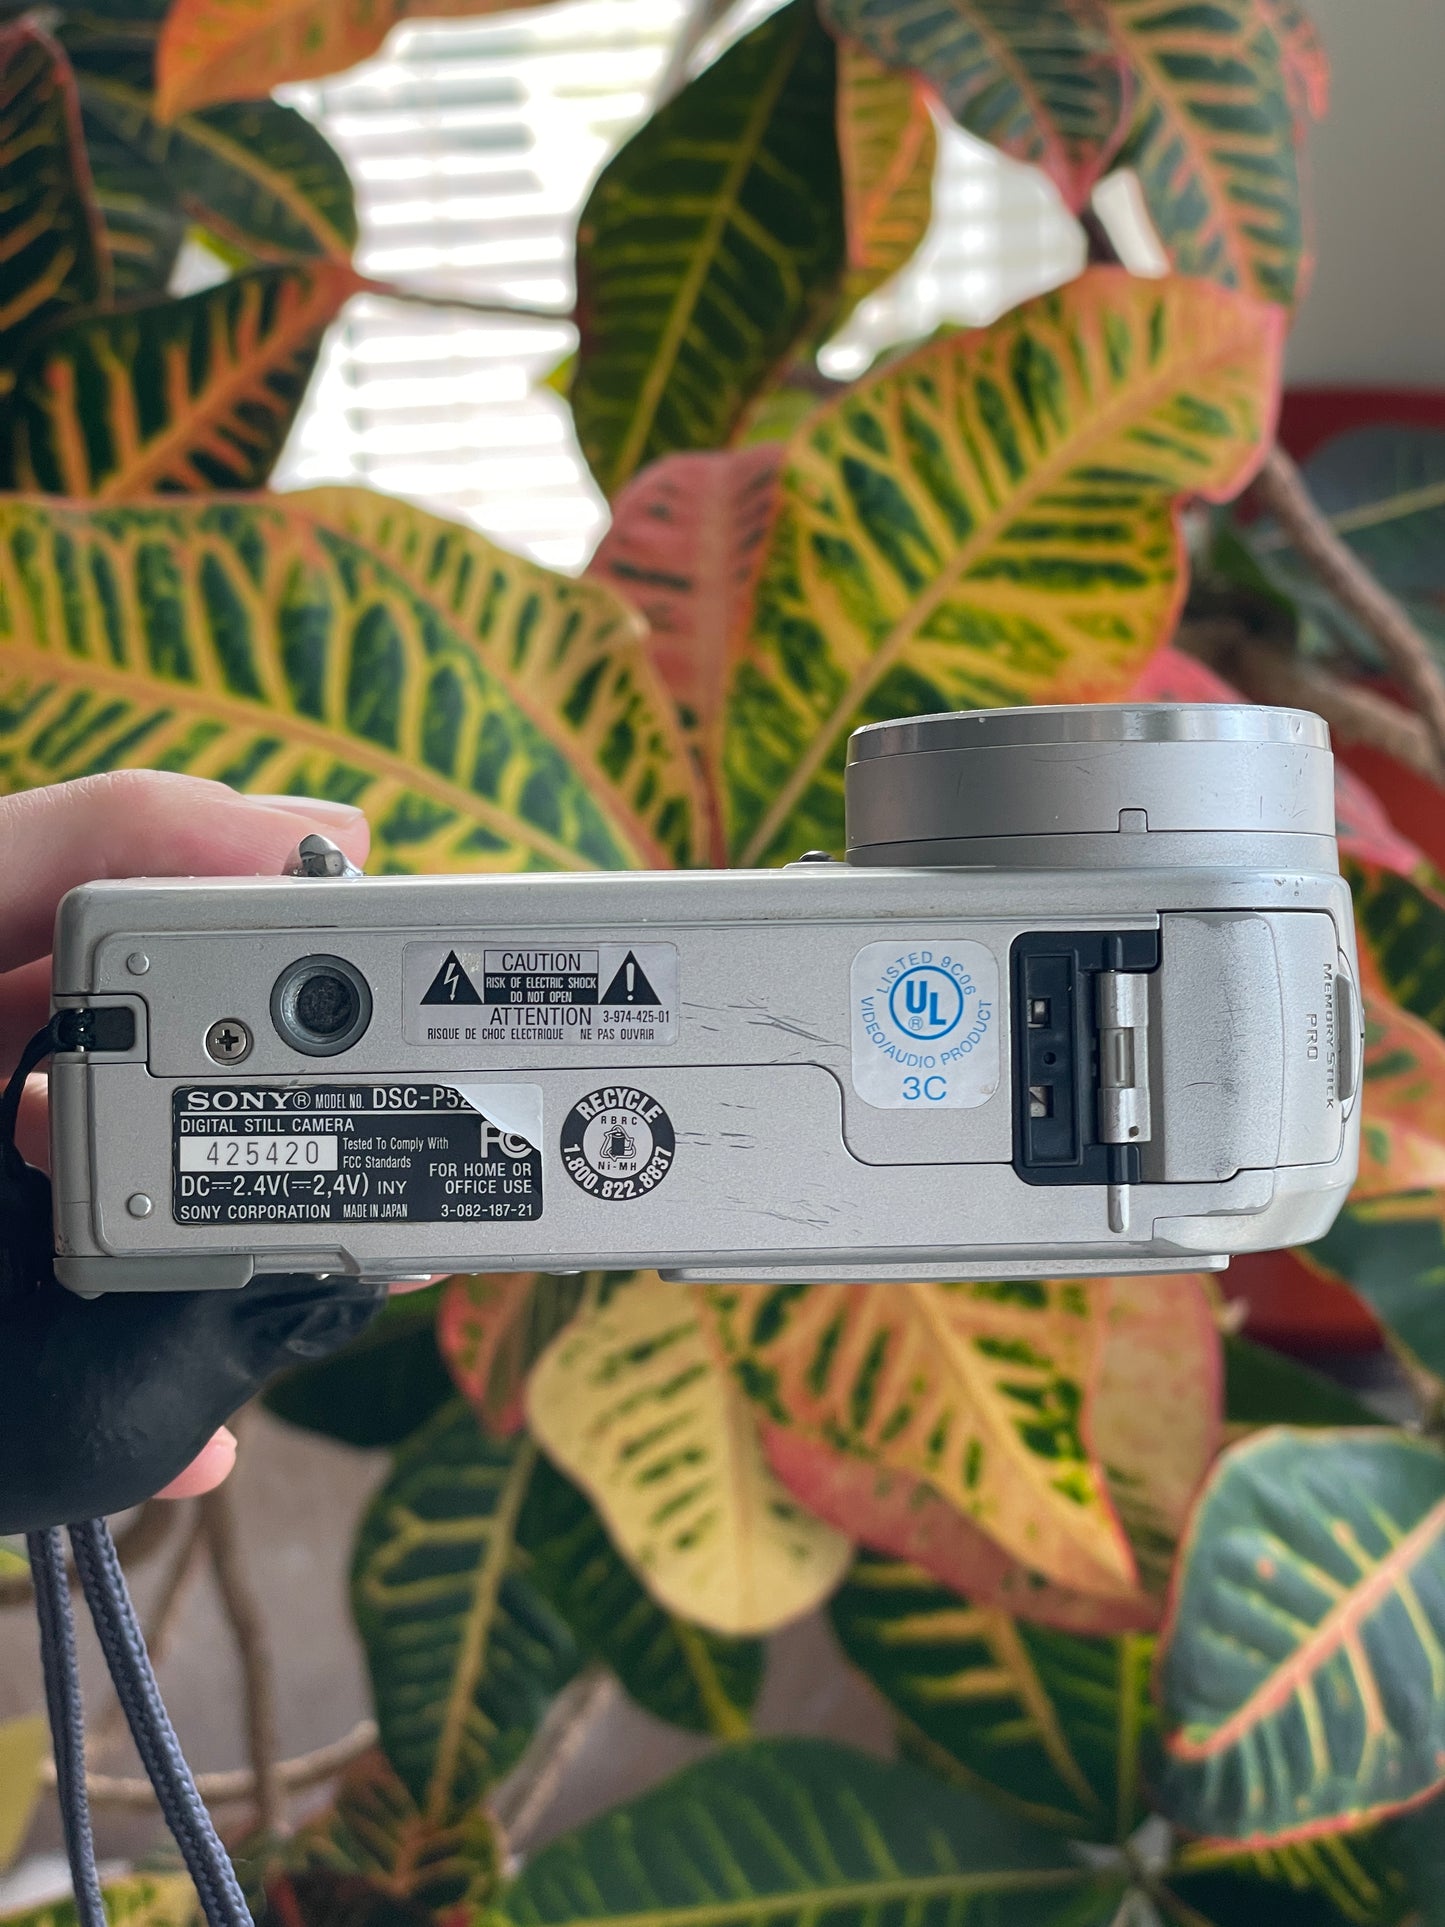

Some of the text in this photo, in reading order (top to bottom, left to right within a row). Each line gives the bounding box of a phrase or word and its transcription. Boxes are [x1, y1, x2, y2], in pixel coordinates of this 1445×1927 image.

[502, 953, 581, 972] CAUTION
[876, 951, 976, 996] LISTED 9C06
[486, 977, 597, 989] RISK OF ELECTRIC SHOCK
[510, 991, 572, 1003] DO NOT OPEN
[906, 980, 947, 1025] UL
[1323, 963, 1335, 1048] MEMORY
[490, 1007, 592, 1026] ATTENTION
[603, 1010, 669, 1024] 3-974-425-01
[427, 1028, 564, 1040] RISQUE DE CHOC ELECTRIQUE
[580, 1028, 655, 1040] NE PAS OUVRIR
[861, 996, 992, 1068] VIDEO/AUDIO PRODUCT
[1306, 1013, 1319, 1062] PRO
[902, 1076, 947, 1101] 3C
[315, 1094, 346, 1109] MODEL
[350, 1093, 365, 1109] NO.
[576, 1088, 663, 1124] RECYCLE
[181, 1118, 355, 1133] DIGITAL STILL CAMERA
[343, 1136, 449, 1153] Tested To Comply With
[207, 1141, 319, 1166] 425420
[343, 1156, 412, 1169] FCC Standards
[429, 1162, 532, 1177] FOR HOME OR
[598, 1161, 637, 1171] Ni-MH
[445, 1180, 532, 1194] OFFICE USE
[181, 1204, 331, 1220] SONY CORPORATION
[343, 1204, 408, 1218] MADE IN JAPAN
[441, 1204, 532, 1217] 3-082-187-21
